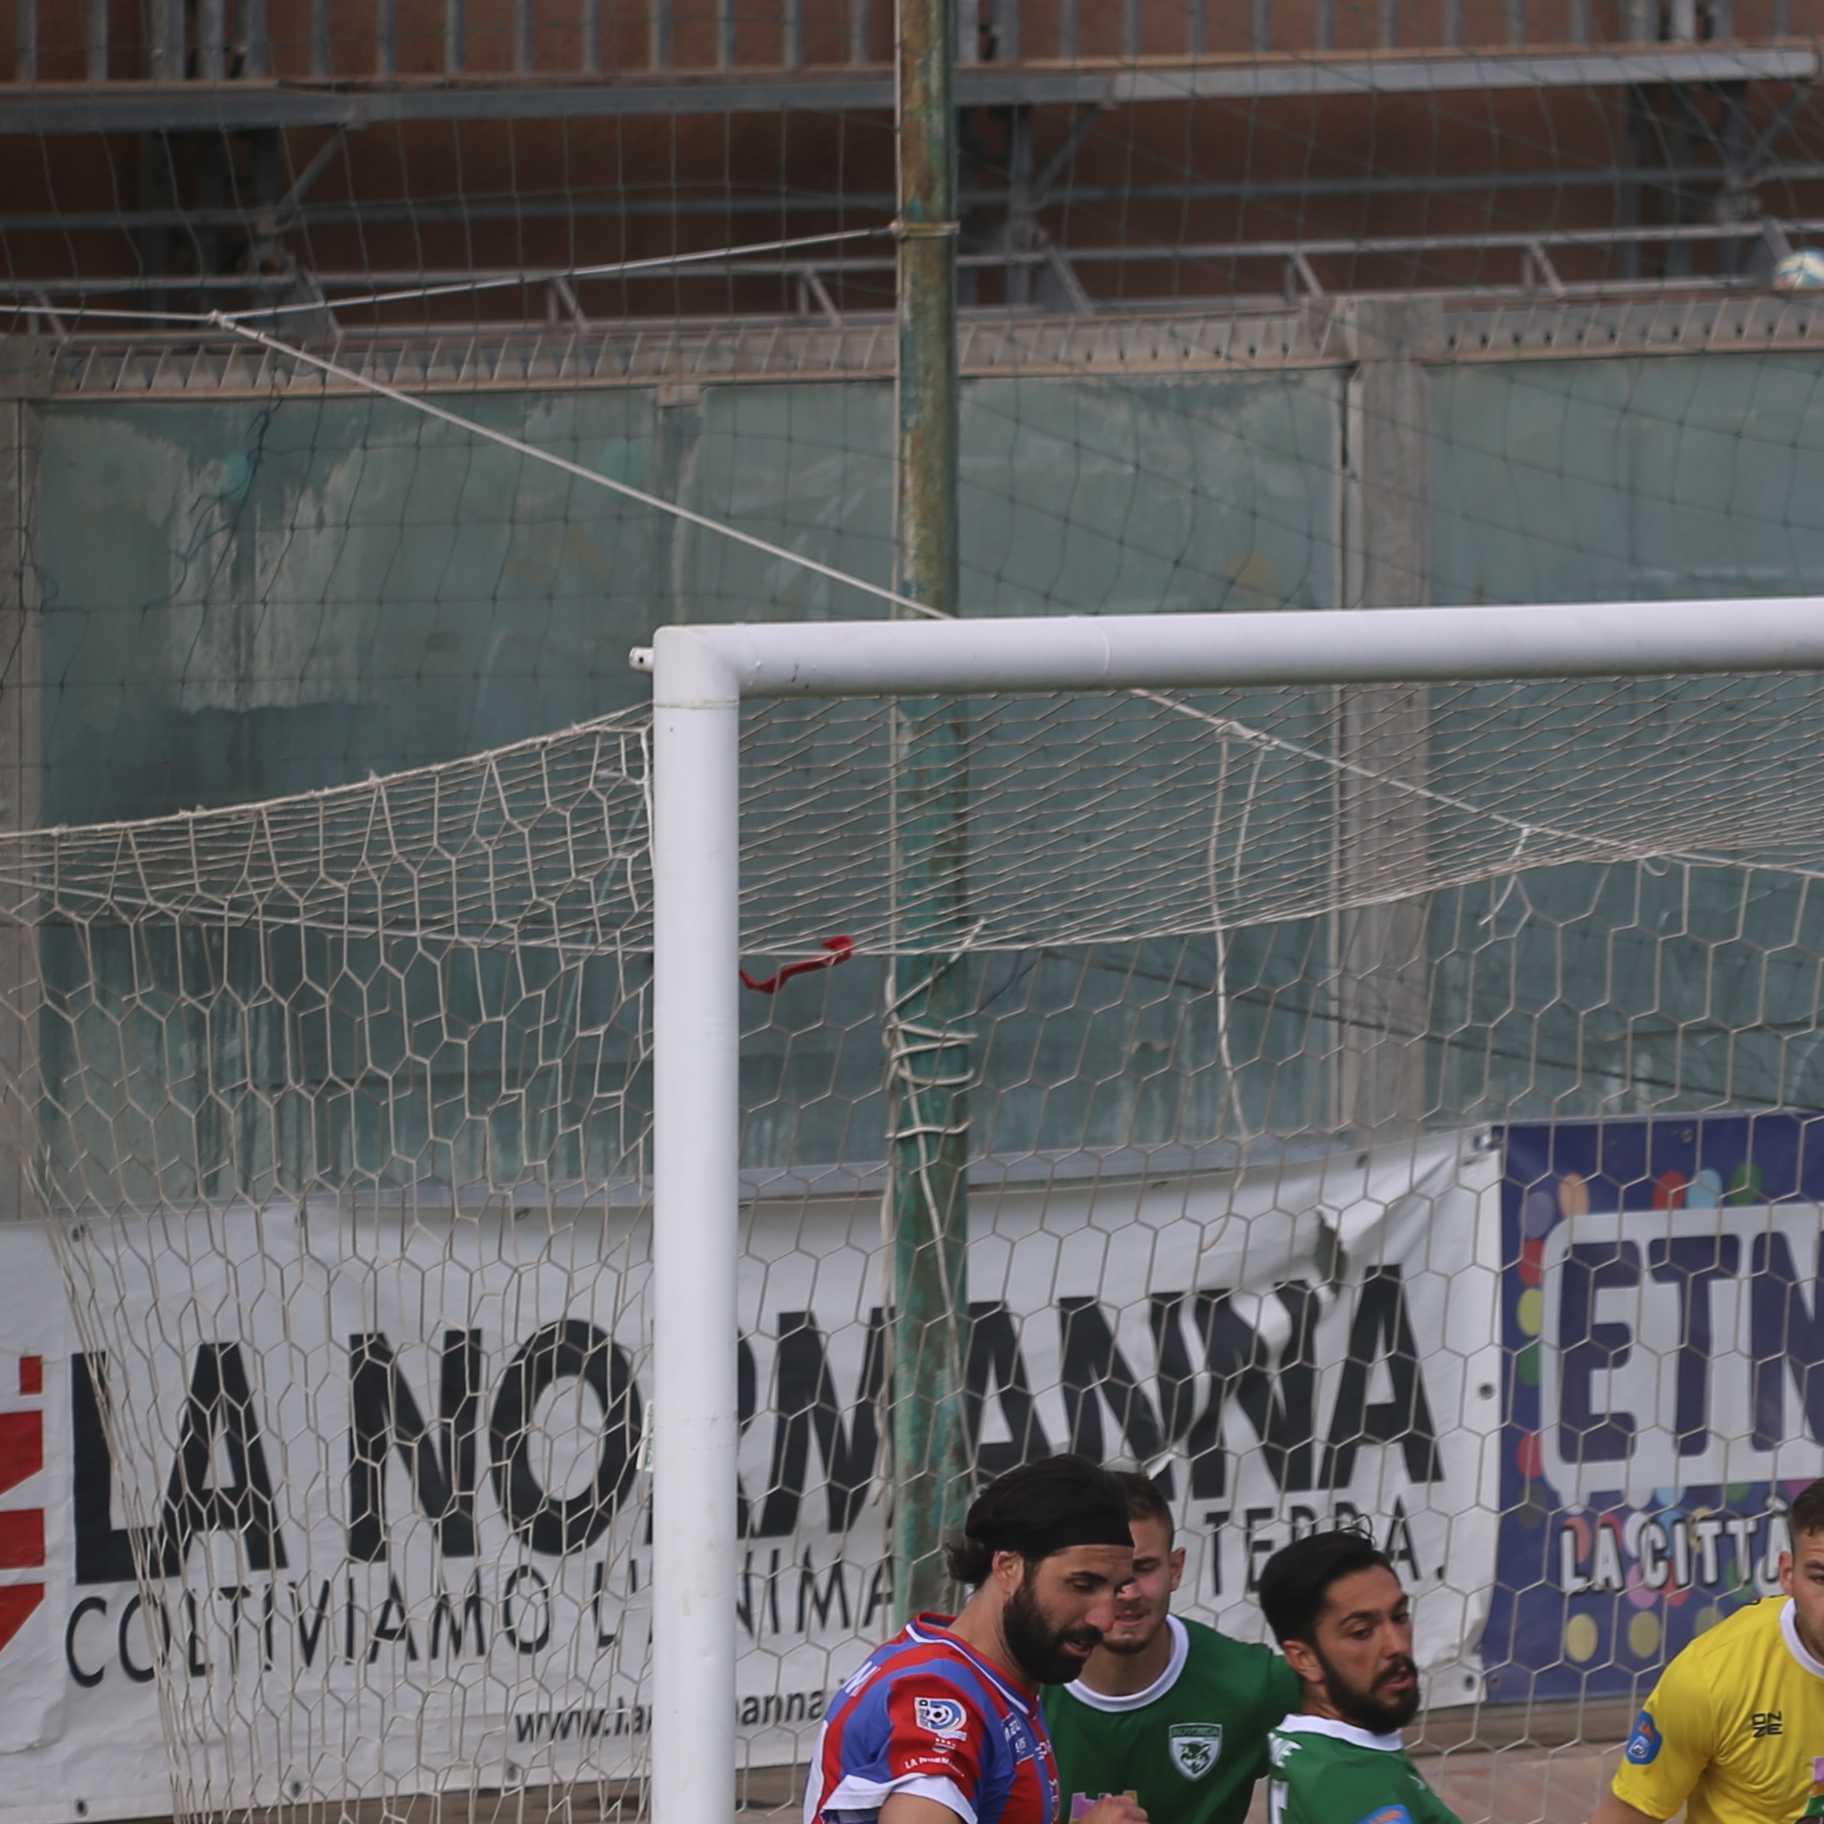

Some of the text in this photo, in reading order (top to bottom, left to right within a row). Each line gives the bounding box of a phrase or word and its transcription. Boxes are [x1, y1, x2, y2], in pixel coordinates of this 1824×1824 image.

[72, 1264, 1444, 1586] LA NOMANNA
[65, 1564, 551, 1688] COLTIVIAMO
[592, 1544, 895, 1648] L'NIMA
[1560, 1524, 1624, 1592] LA
